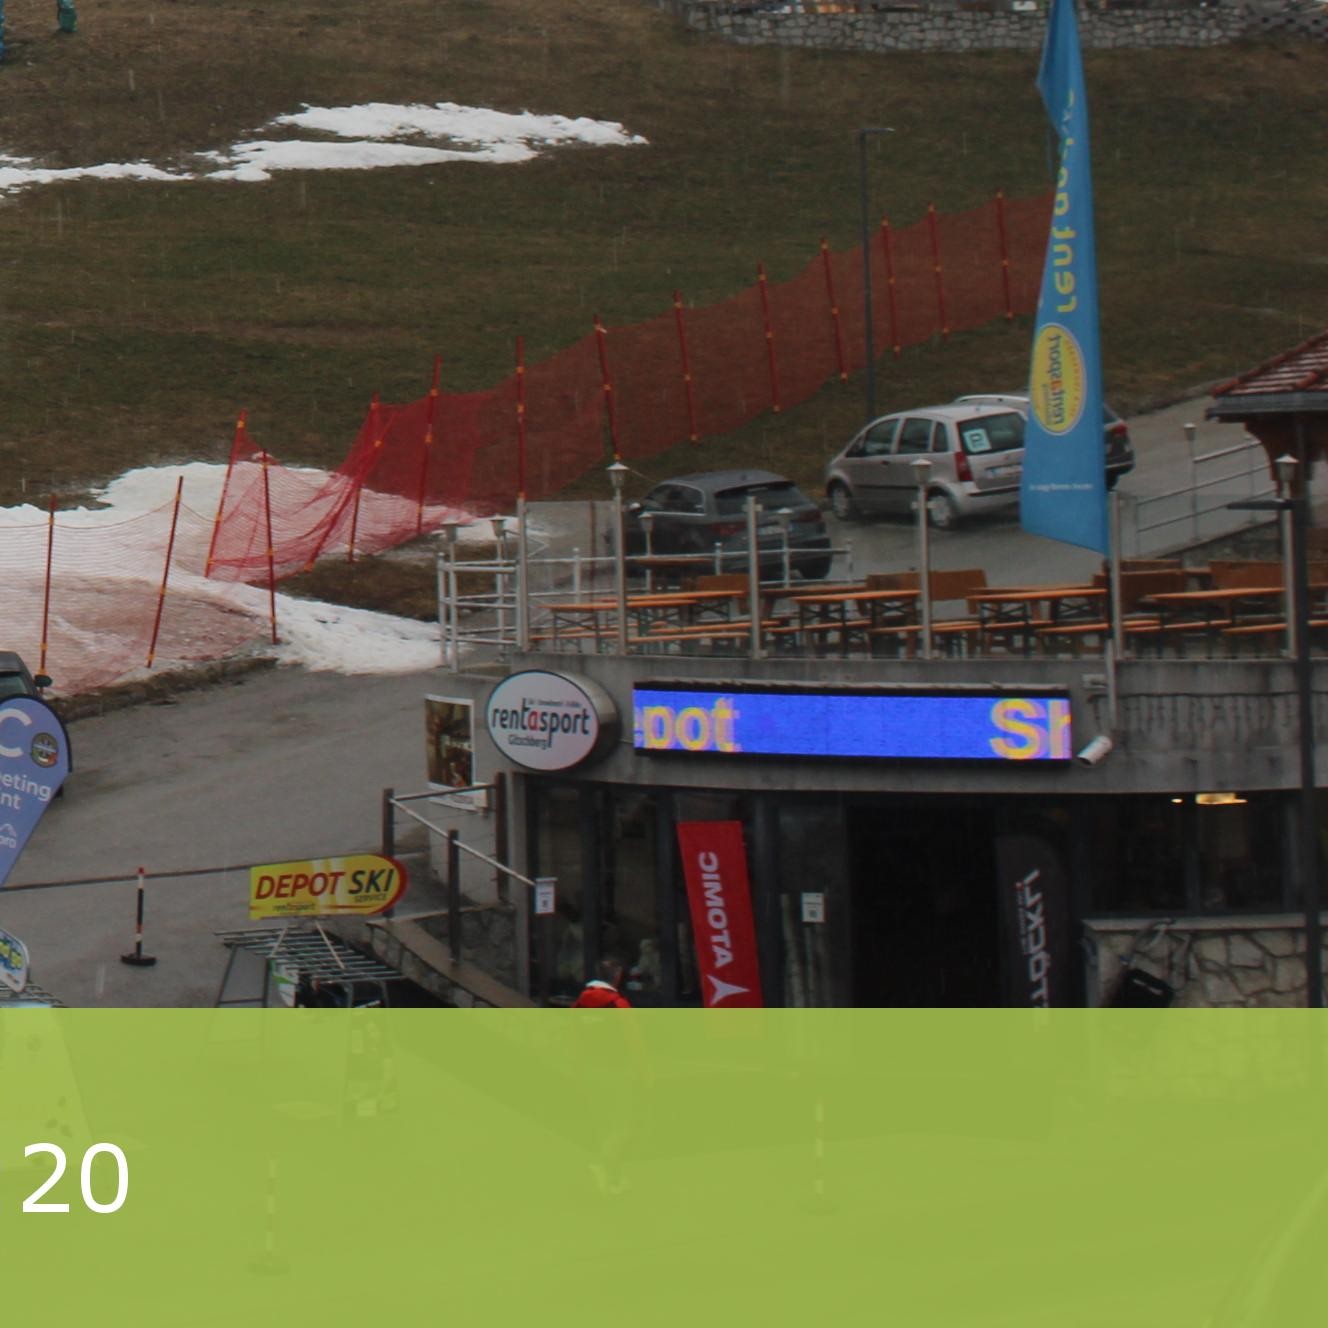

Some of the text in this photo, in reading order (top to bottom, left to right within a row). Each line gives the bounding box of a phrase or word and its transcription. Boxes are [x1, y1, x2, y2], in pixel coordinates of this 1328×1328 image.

[492, 697, 592, 748] rentasport
[256, 868, 396, 899] DEPOT SKI
